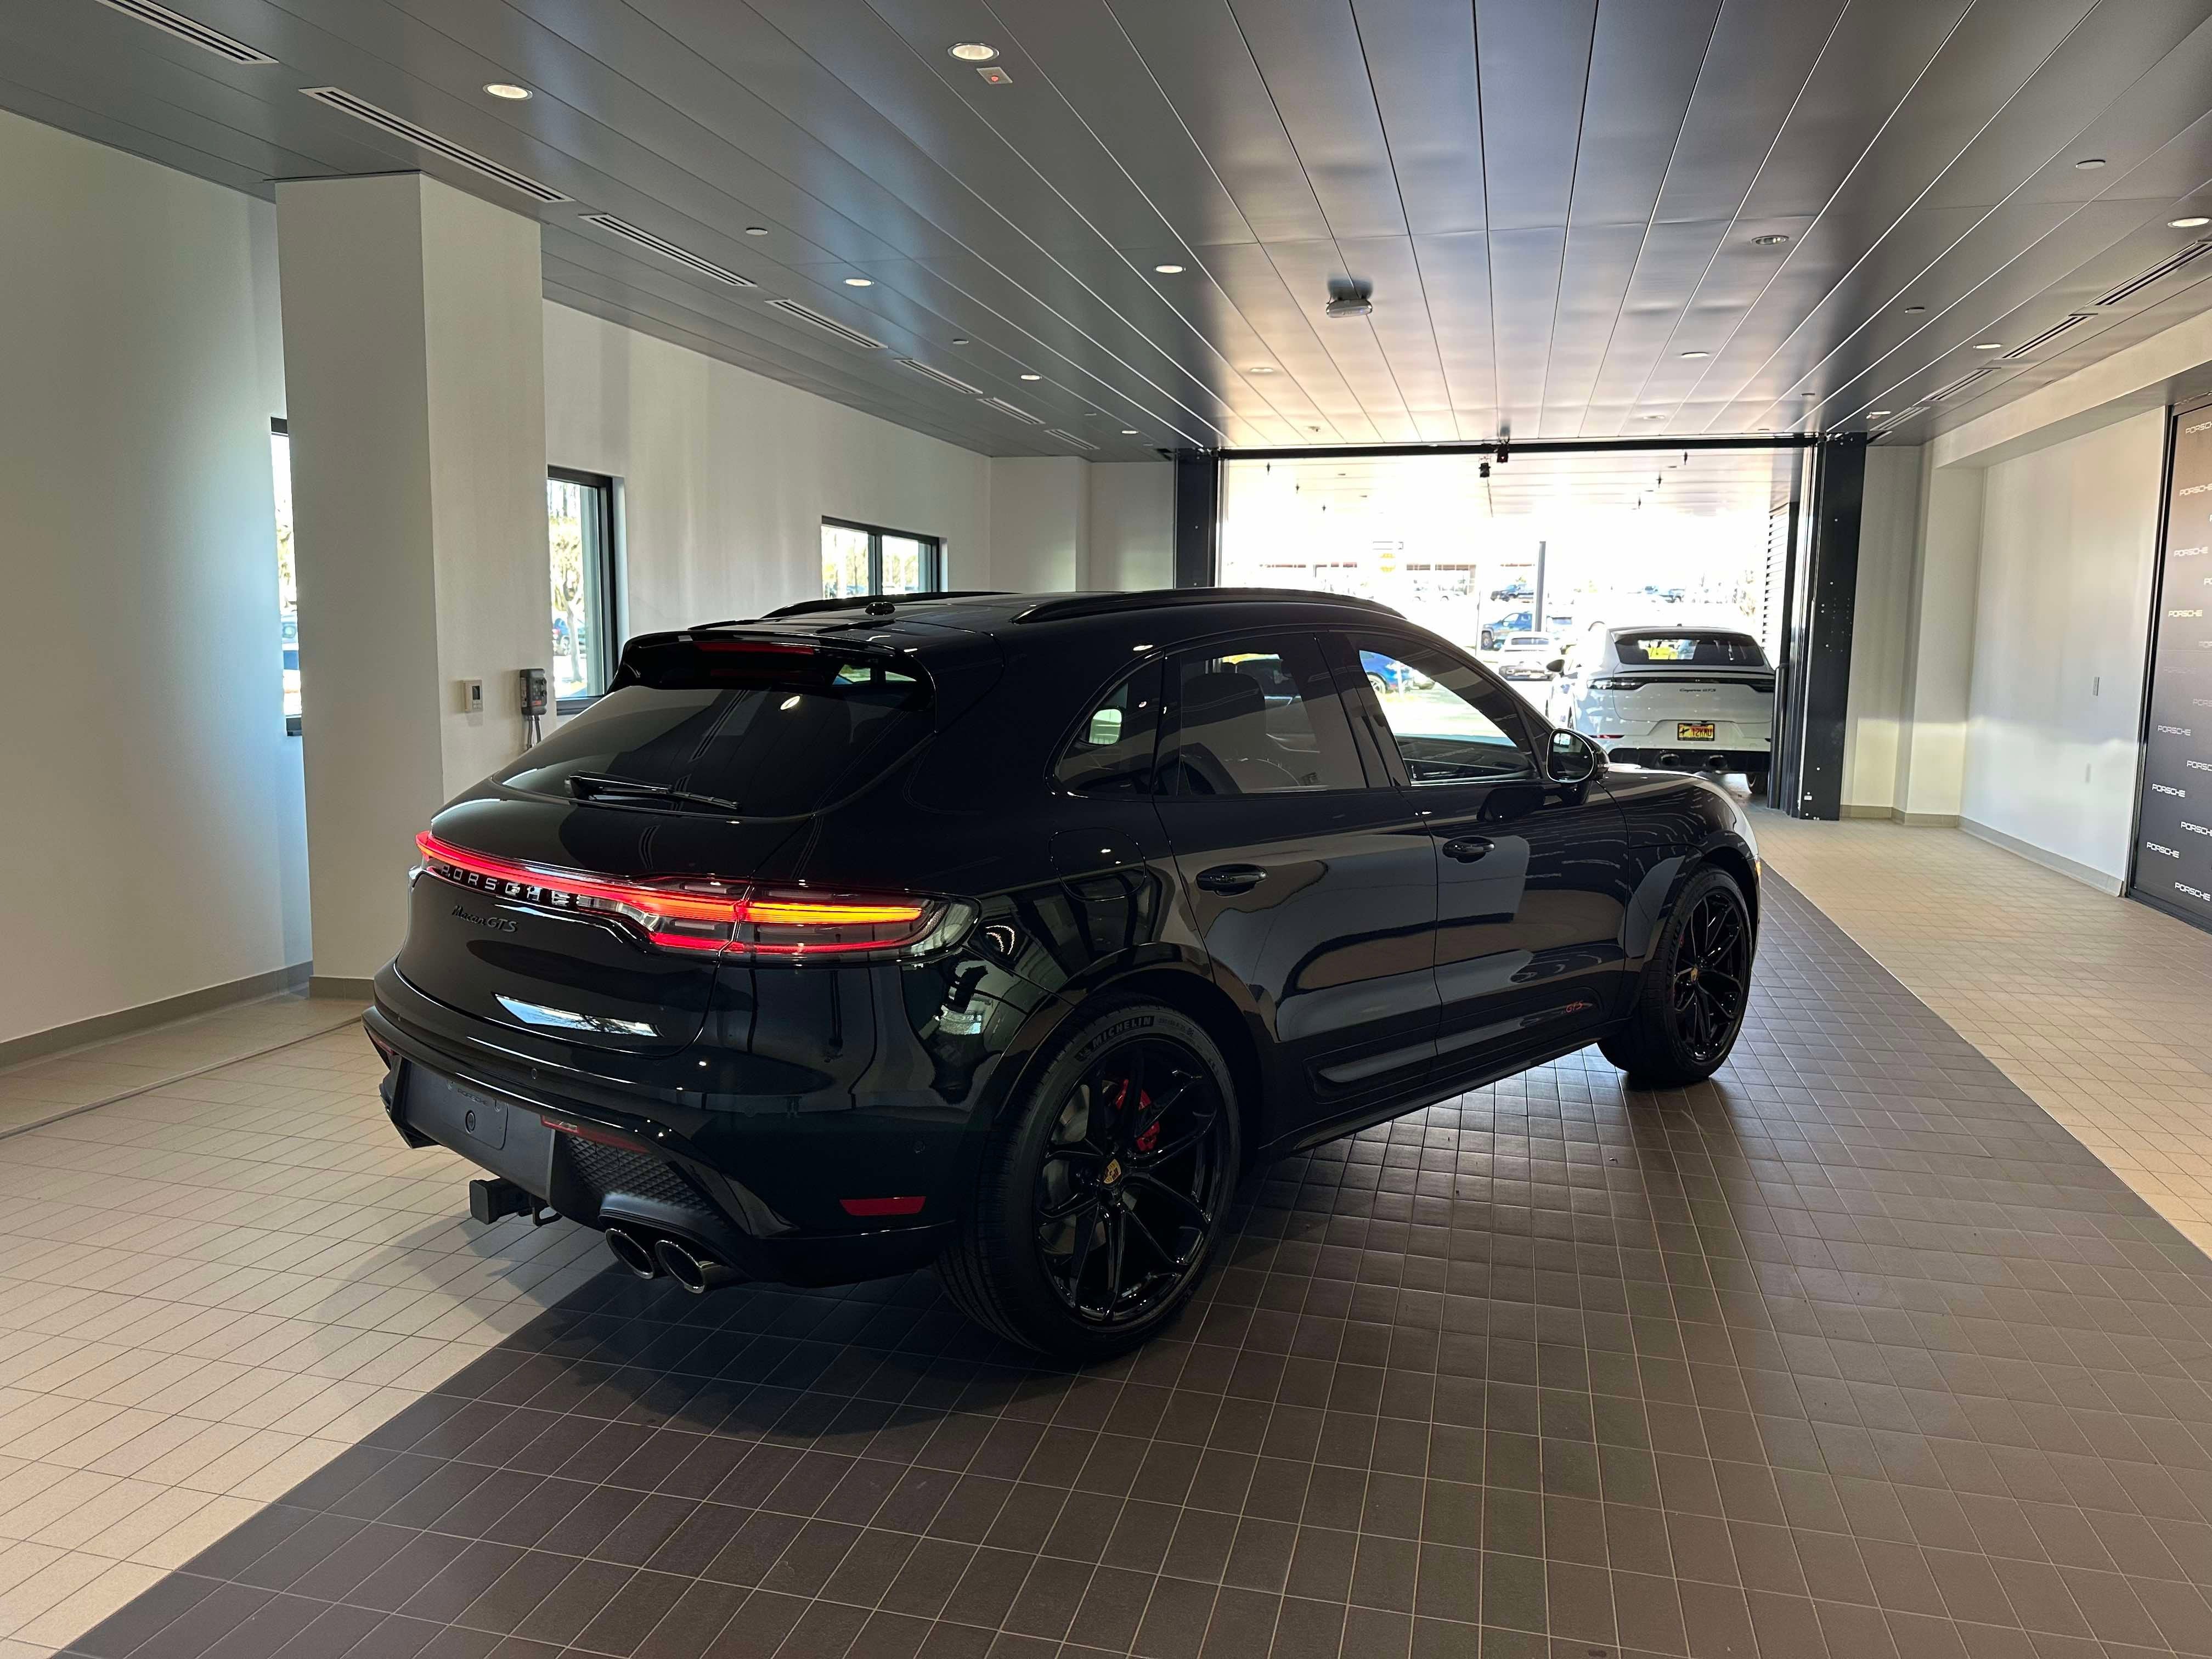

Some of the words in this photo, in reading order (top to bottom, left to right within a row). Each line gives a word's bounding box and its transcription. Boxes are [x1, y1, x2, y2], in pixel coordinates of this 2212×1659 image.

[2174, 546, 2208, 557] PORSCHE
[2168, 609, 2203, 618] PORSCHE
[2158, 724, 2192, 737] PORSCHE
[2152, 783, 2186, 798] PORSCHE
[2146, 842, 2180, 859] PORSCHE
[441, 864, 571, 907] PORSCHE
[2174, 882, 2211, 902] PORSCHE
[452, 903, 486, 927] Macan
[486, 916, 518, 933] GTS
[1566, 1000, 1584, 1013] GTS
[1092, 1016, 1152, 1049] MICHELIN
